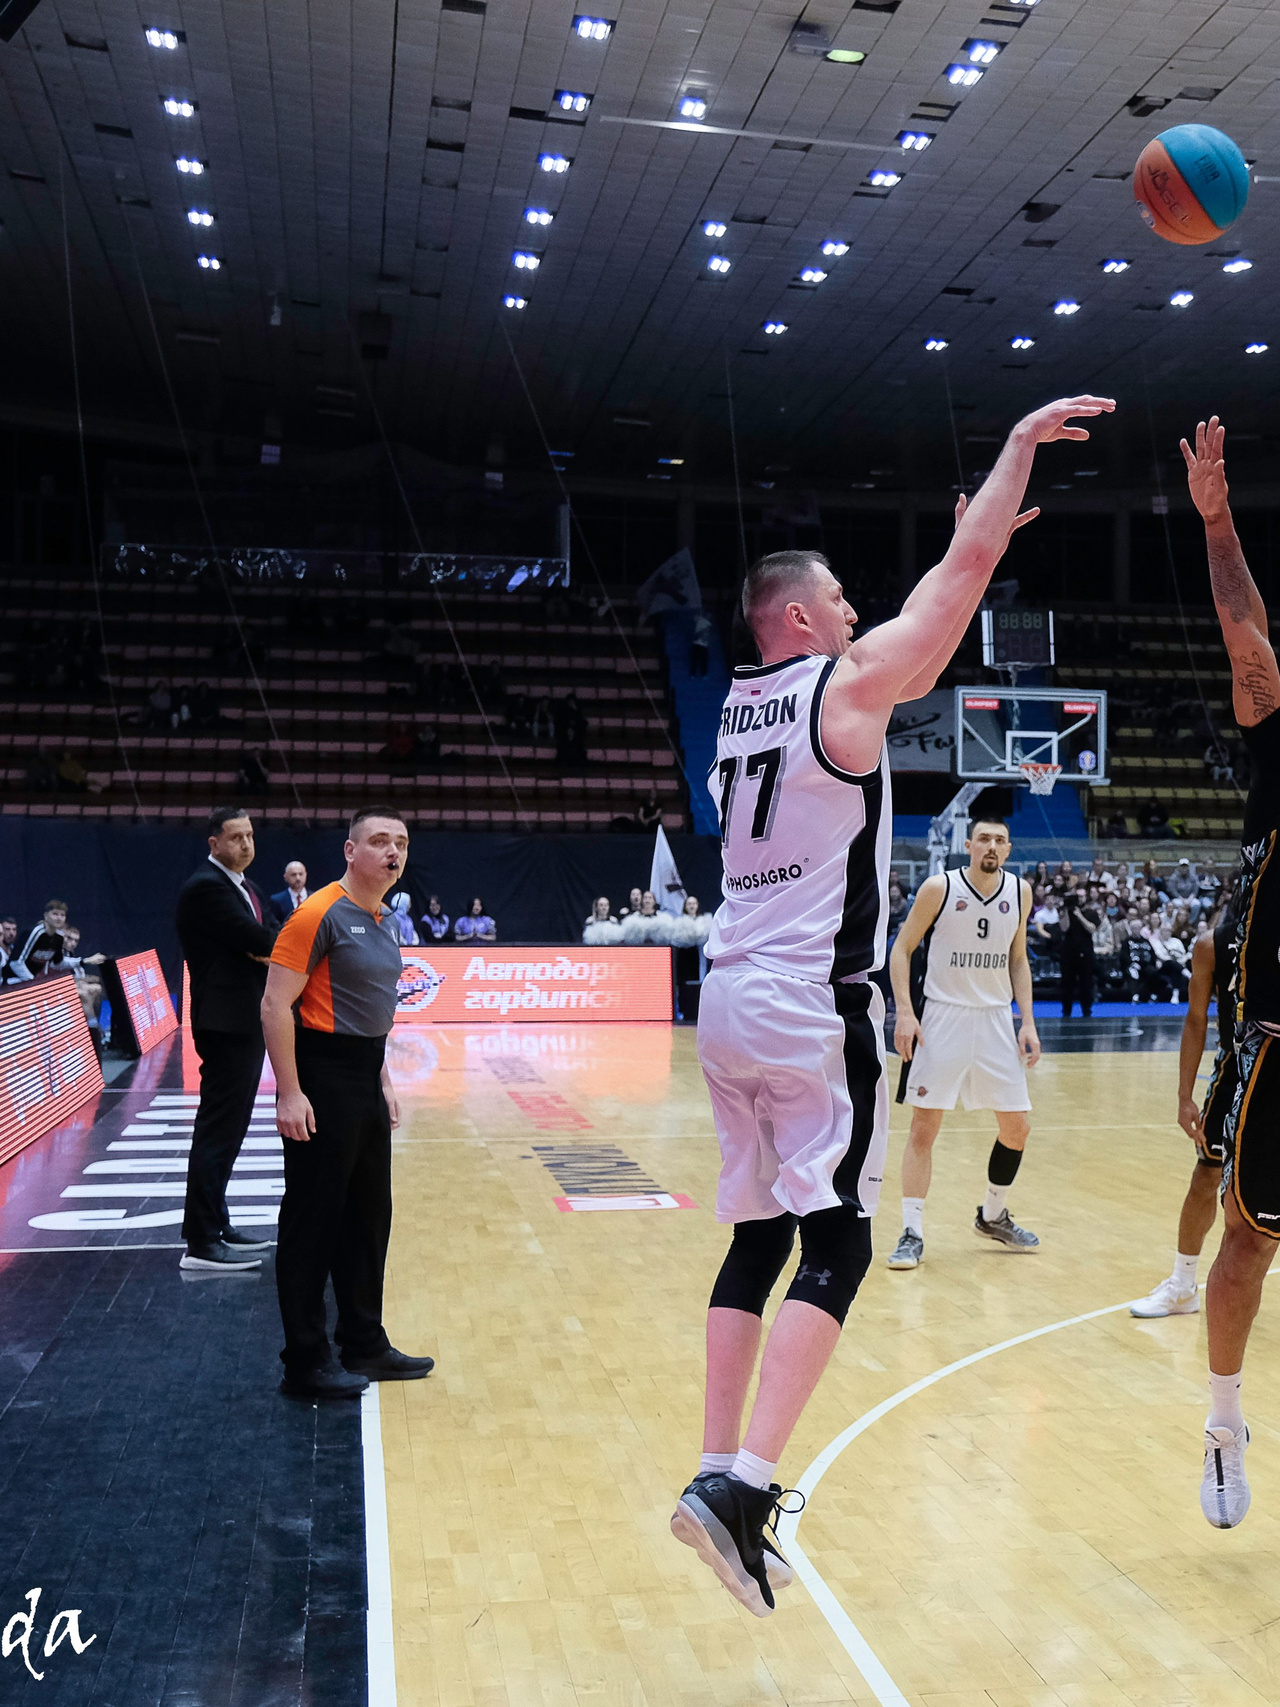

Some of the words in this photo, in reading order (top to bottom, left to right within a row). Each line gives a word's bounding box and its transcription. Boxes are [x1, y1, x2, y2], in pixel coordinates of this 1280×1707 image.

[719, 744, 788, 849] 77
[731, 863, 803, 892] PHOSAGRO
[976, 918, 990, 939] 9
